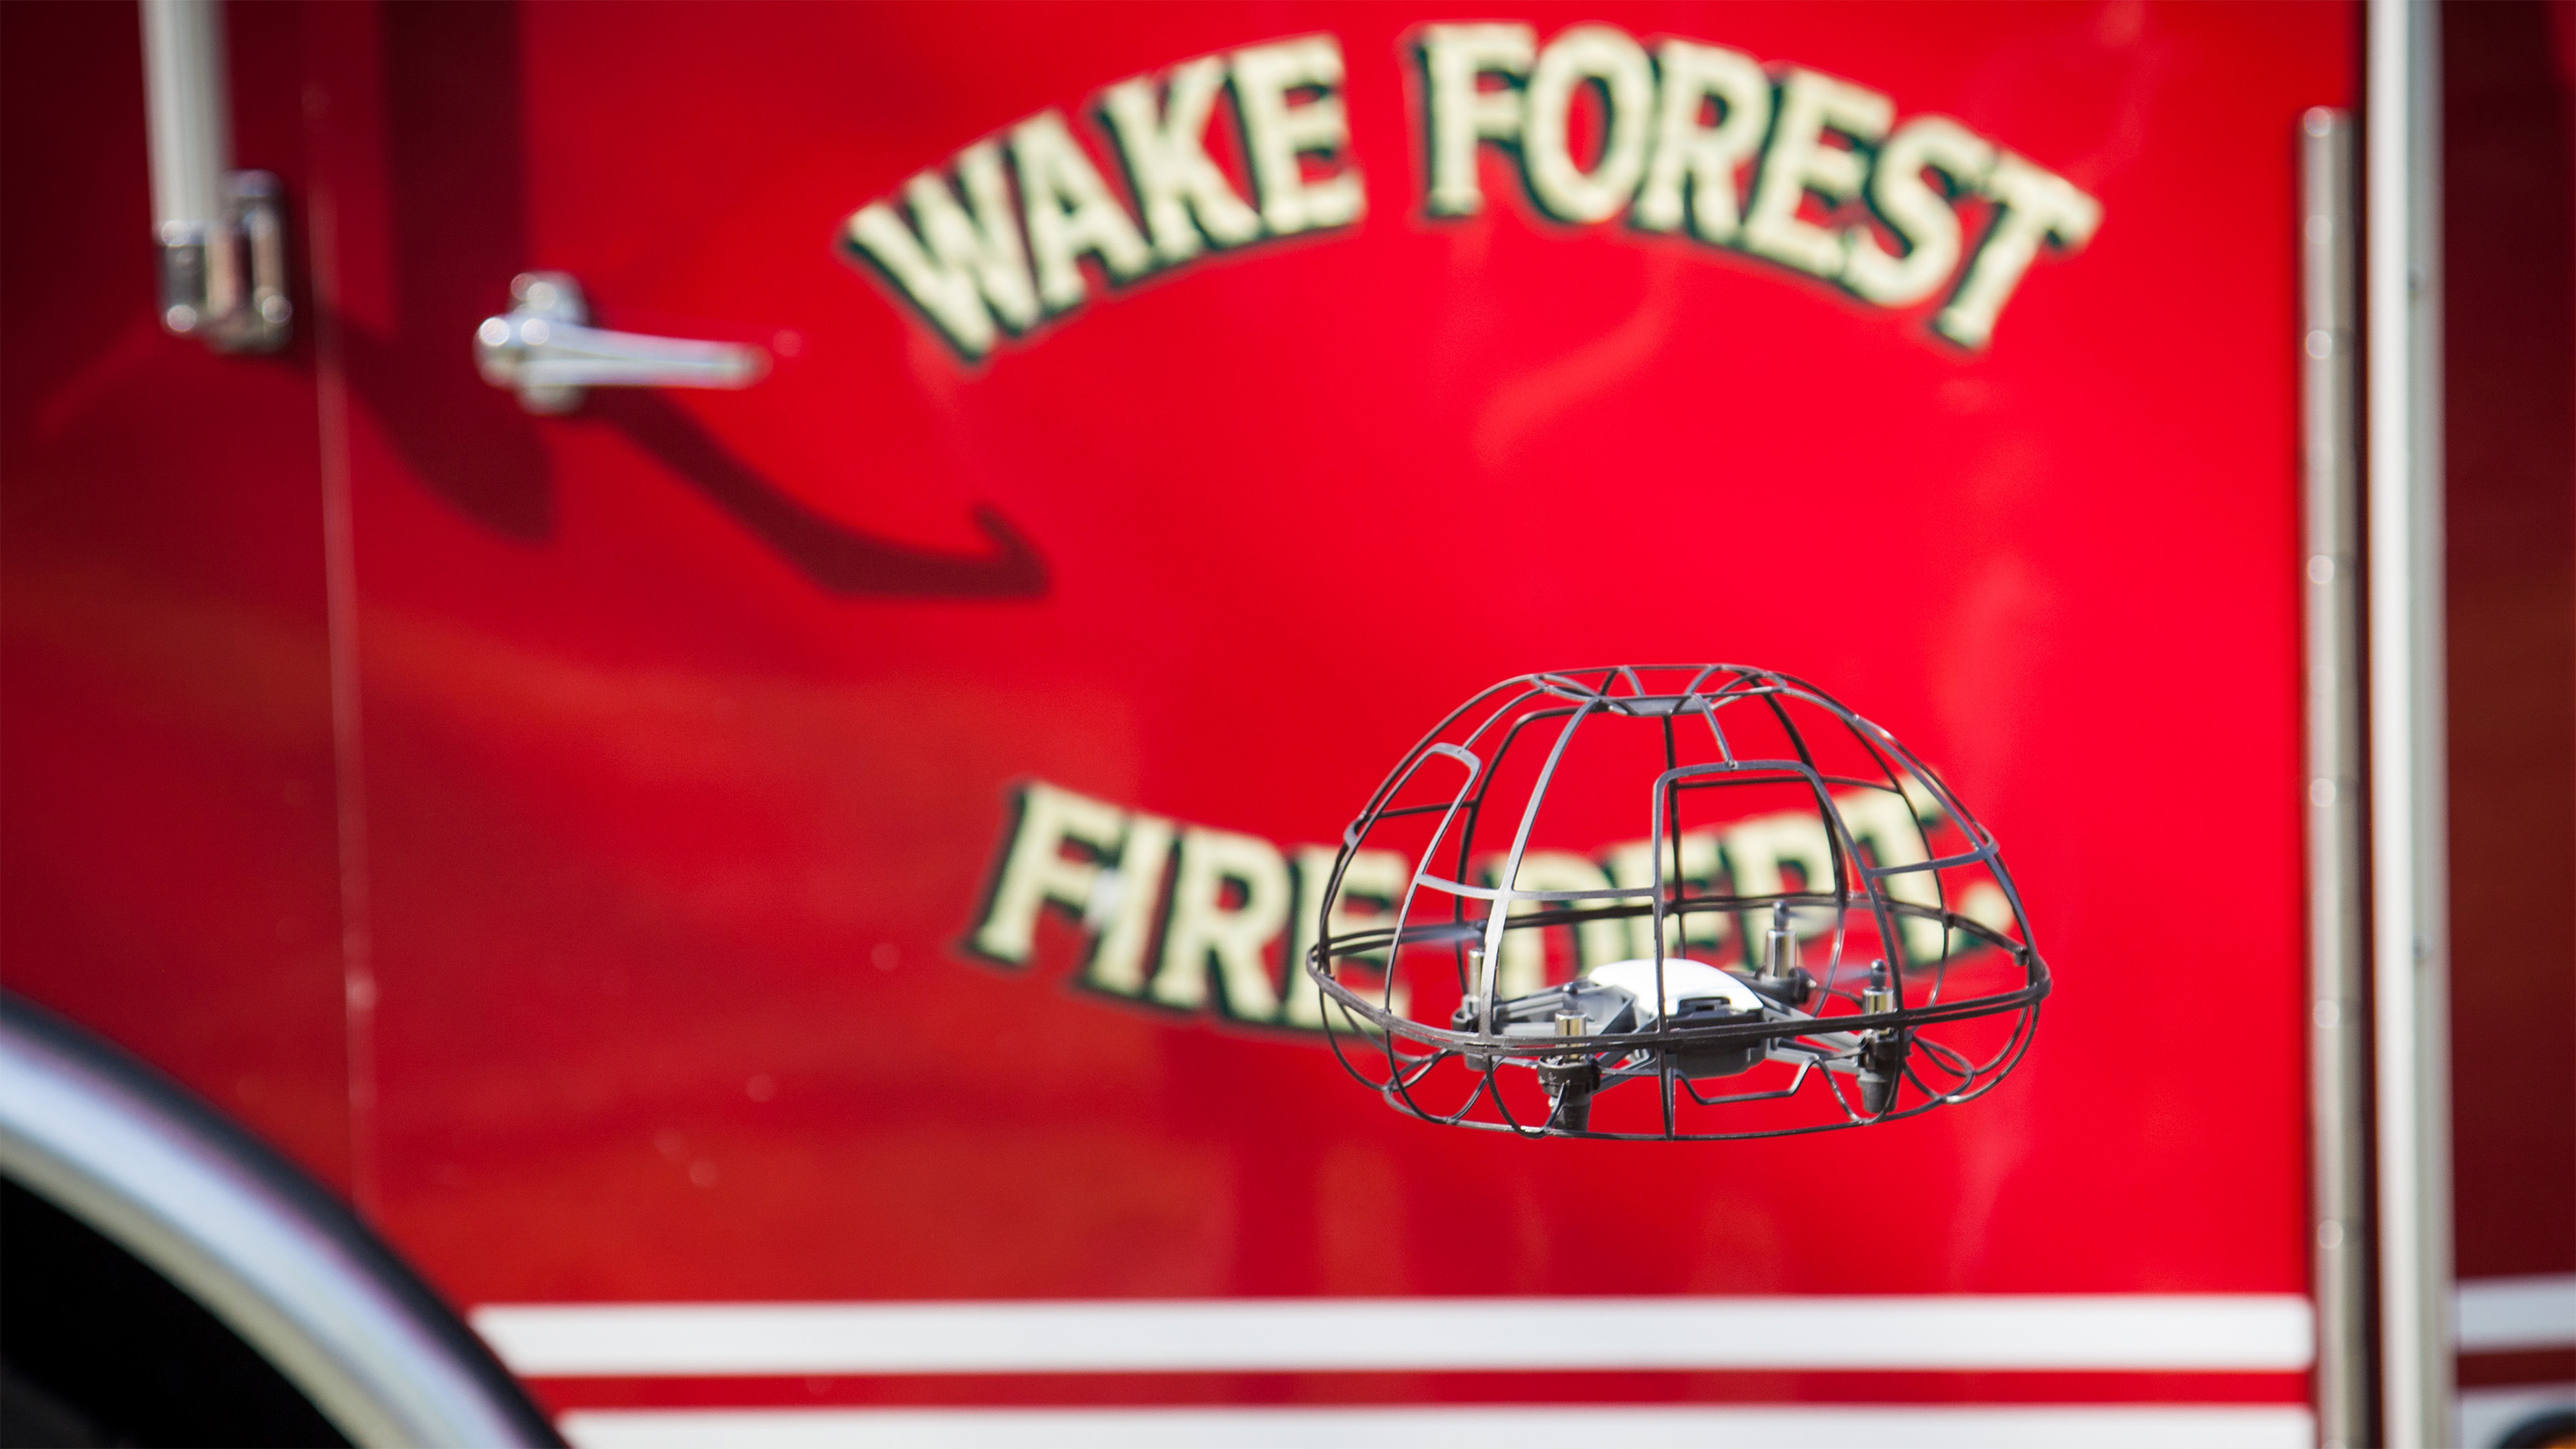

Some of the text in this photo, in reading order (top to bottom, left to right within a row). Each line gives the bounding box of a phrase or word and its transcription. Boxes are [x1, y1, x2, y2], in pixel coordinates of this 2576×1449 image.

[842, 23, 2101, 362] WAKE FOREST
[963, 781, 1412, 1035] FIRE
